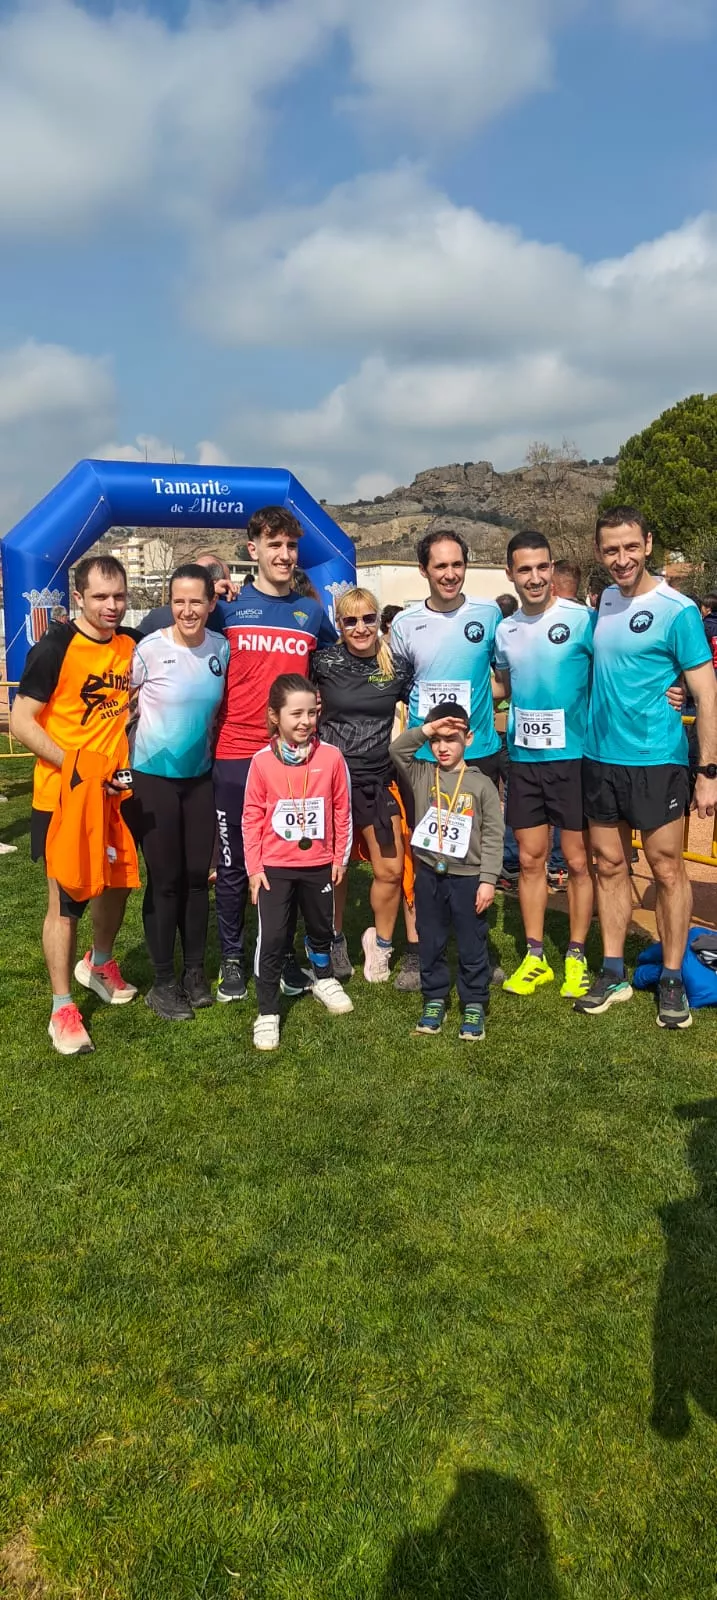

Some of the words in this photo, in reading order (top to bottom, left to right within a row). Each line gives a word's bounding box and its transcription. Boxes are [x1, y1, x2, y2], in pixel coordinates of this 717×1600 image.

[151, 478, 231, 495] Tamarite
[170, 504, 184, 513] de
[238, 635, 309, 656] HINACO
[430, 692, 458, 704] 129
[98, 699, 119, 711] club
[523, 722, 552, 735] 095
[286, 812, 317, 826] 082
